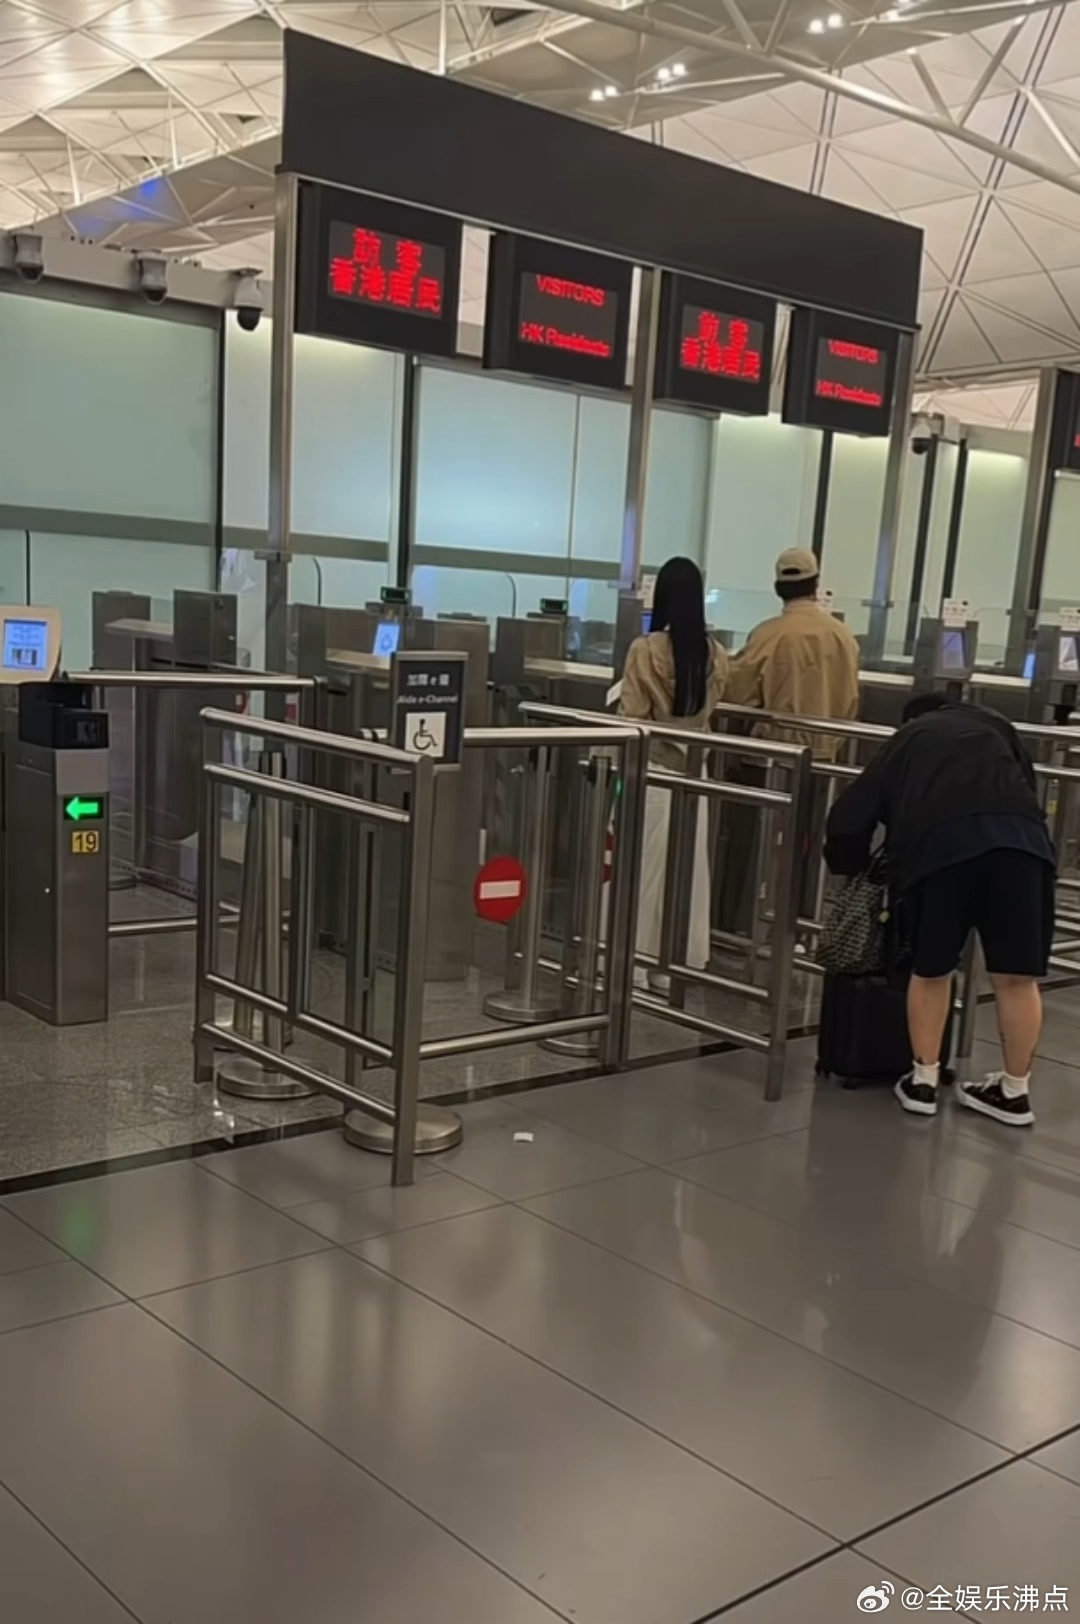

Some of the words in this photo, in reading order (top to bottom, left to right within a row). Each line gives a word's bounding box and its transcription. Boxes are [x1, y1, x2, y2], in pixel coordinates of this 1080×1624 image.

[330, 257, 441, 313] 香港居民
[536, 274, 605, 307] VISITORS
[521, 322, 544, 344] HK
[546, 328, 610, 357] Residents
[828, 339, 878, 364] VISITORS
[681, 337, 760, 379] 香港居民
[815, 380, 835, 398] HK
[835, 383, 882, 407] Residents
[75, 832, 97, 852] 19
